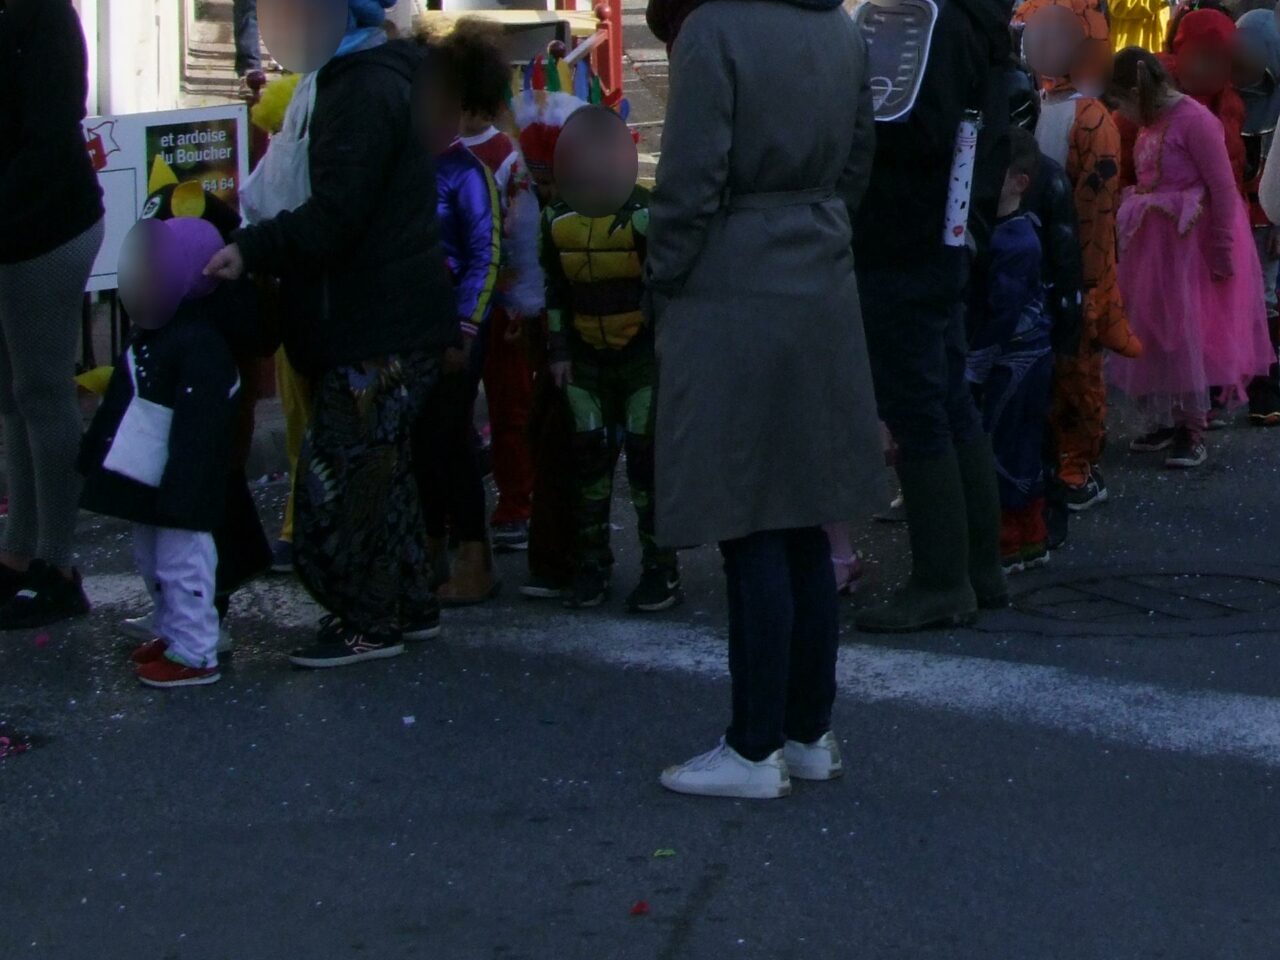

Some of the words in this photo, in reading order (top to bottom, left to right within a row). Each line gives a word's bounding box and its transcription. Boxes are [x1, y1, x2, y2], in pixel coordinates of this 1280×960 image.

[160, 132, 175, 147] et
[177, 128, 227, 146] ardoise
[176, 146, 232, 163] Boucher
